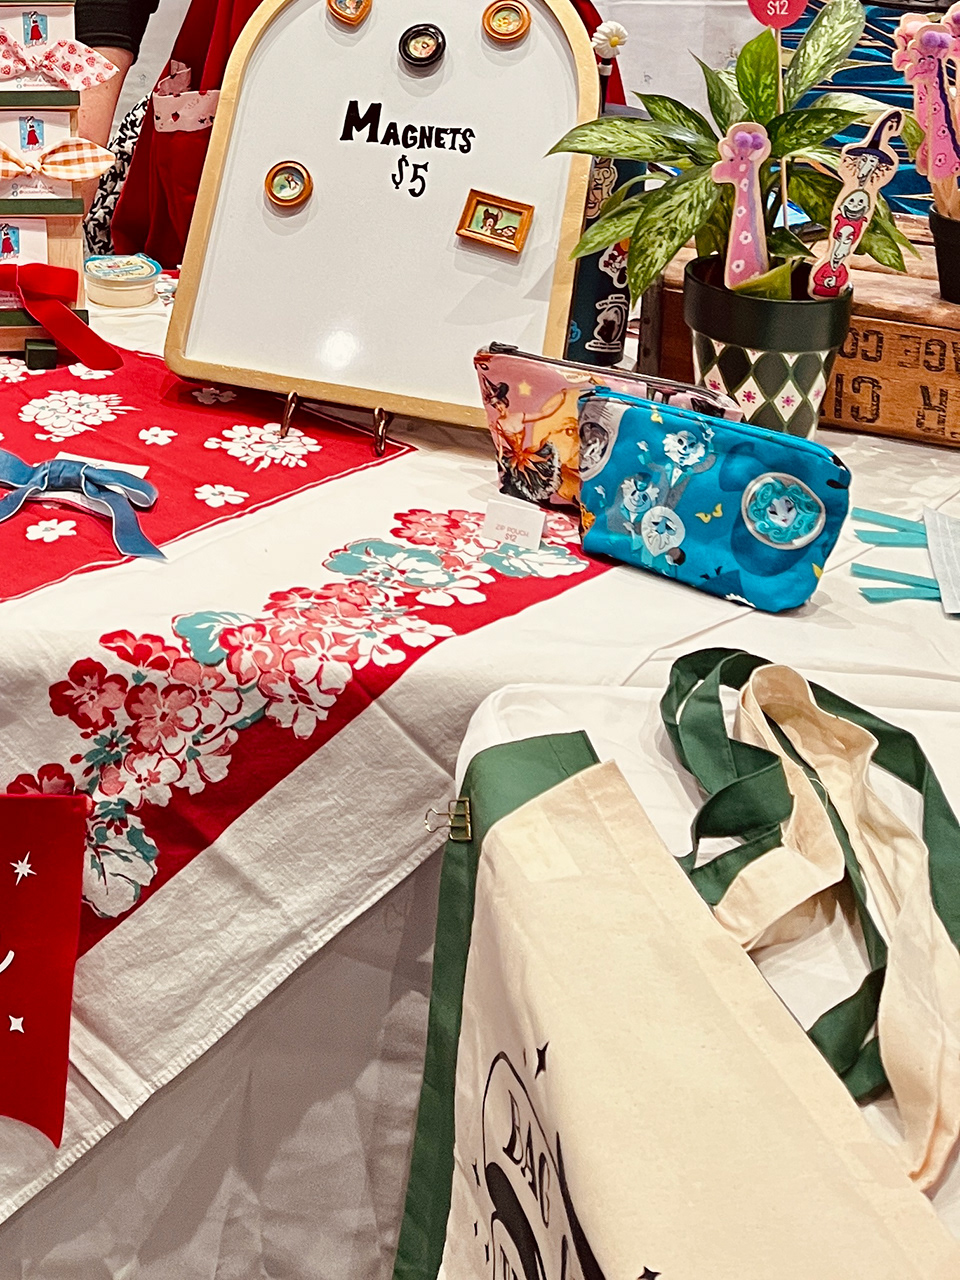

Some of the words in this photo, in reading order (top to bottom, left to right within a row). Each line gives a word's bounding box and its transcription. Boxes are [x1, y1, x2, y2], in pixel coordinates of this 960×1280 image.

[766, 0, 789, 16] $12
[339, 100, 476, 154] MAGNETS
[391, 154, 429, 198] $5
